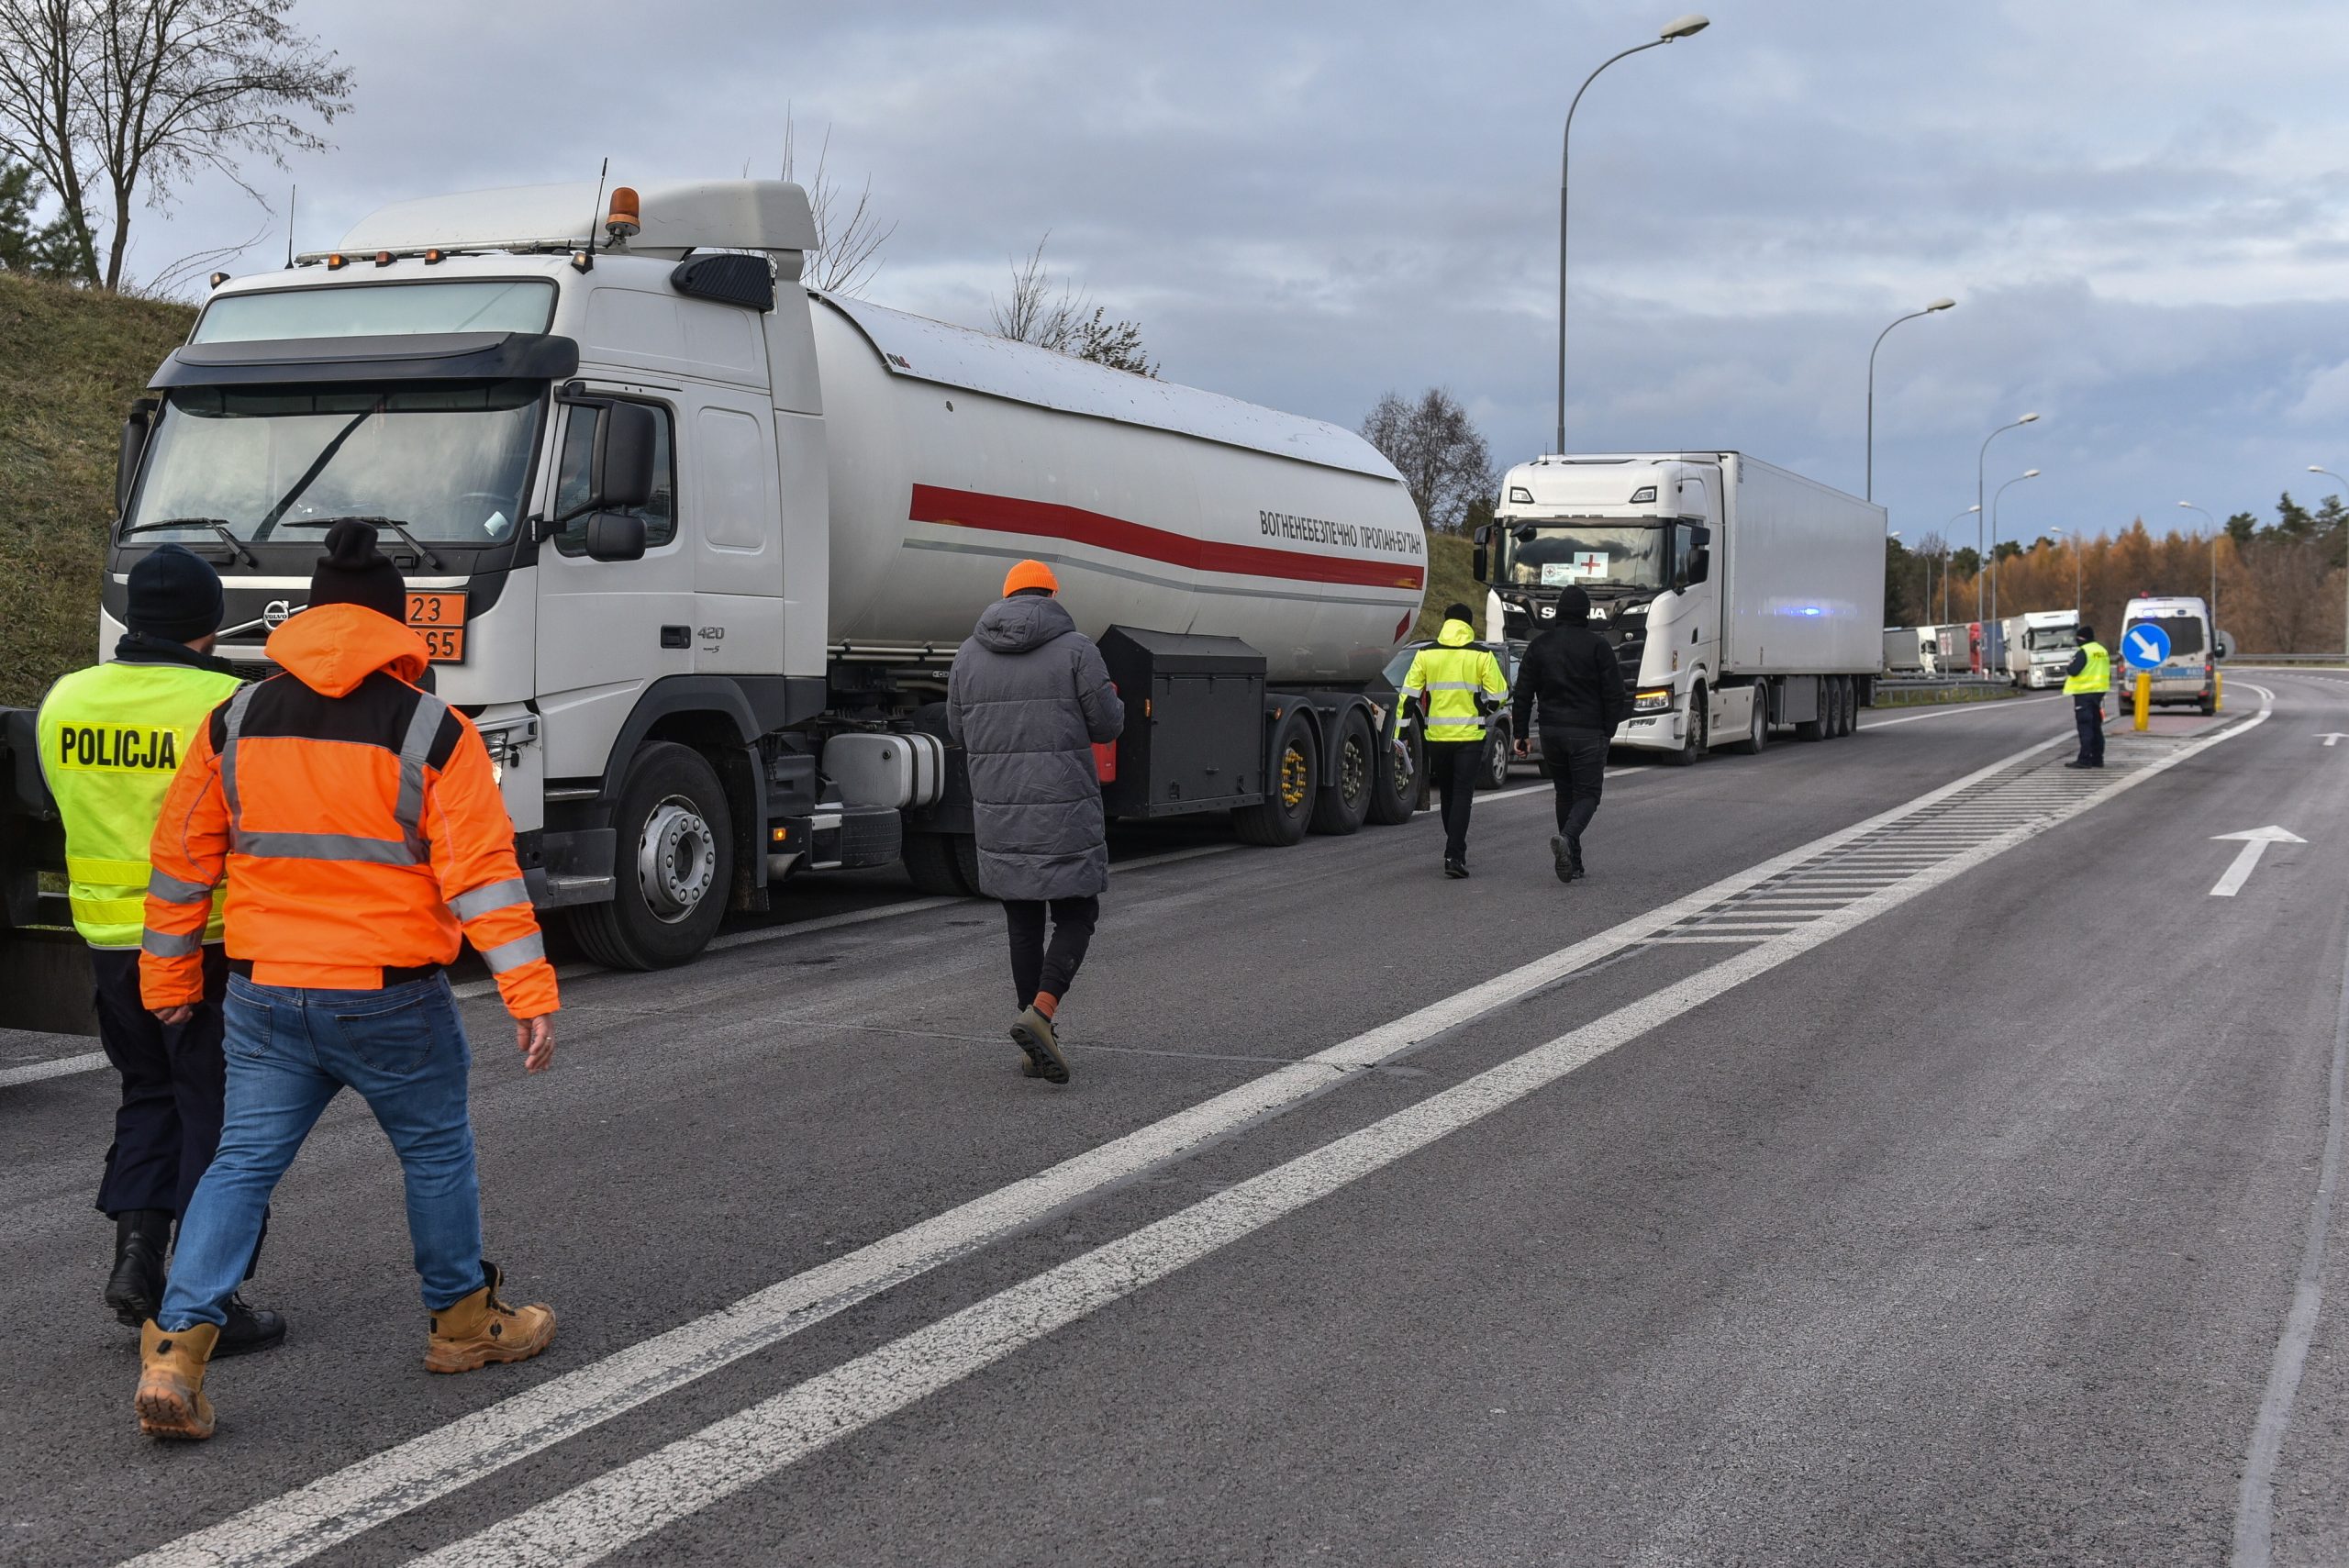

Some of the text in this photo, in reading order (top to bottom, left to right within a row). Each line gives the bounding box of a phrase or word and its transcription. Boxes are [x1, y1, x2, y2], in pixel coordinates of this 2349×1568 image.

[1260, 510, 1422, 555] ВОГНЕНЕБЕЗПЕЧНО ПРОПАН-БУТАН
[410, 597, 441, 622] 23
[1541, 606, 1607, 620] SIA
[697, 627, 725, 639] 420
[61, 728, 177, 769] POLICJA
